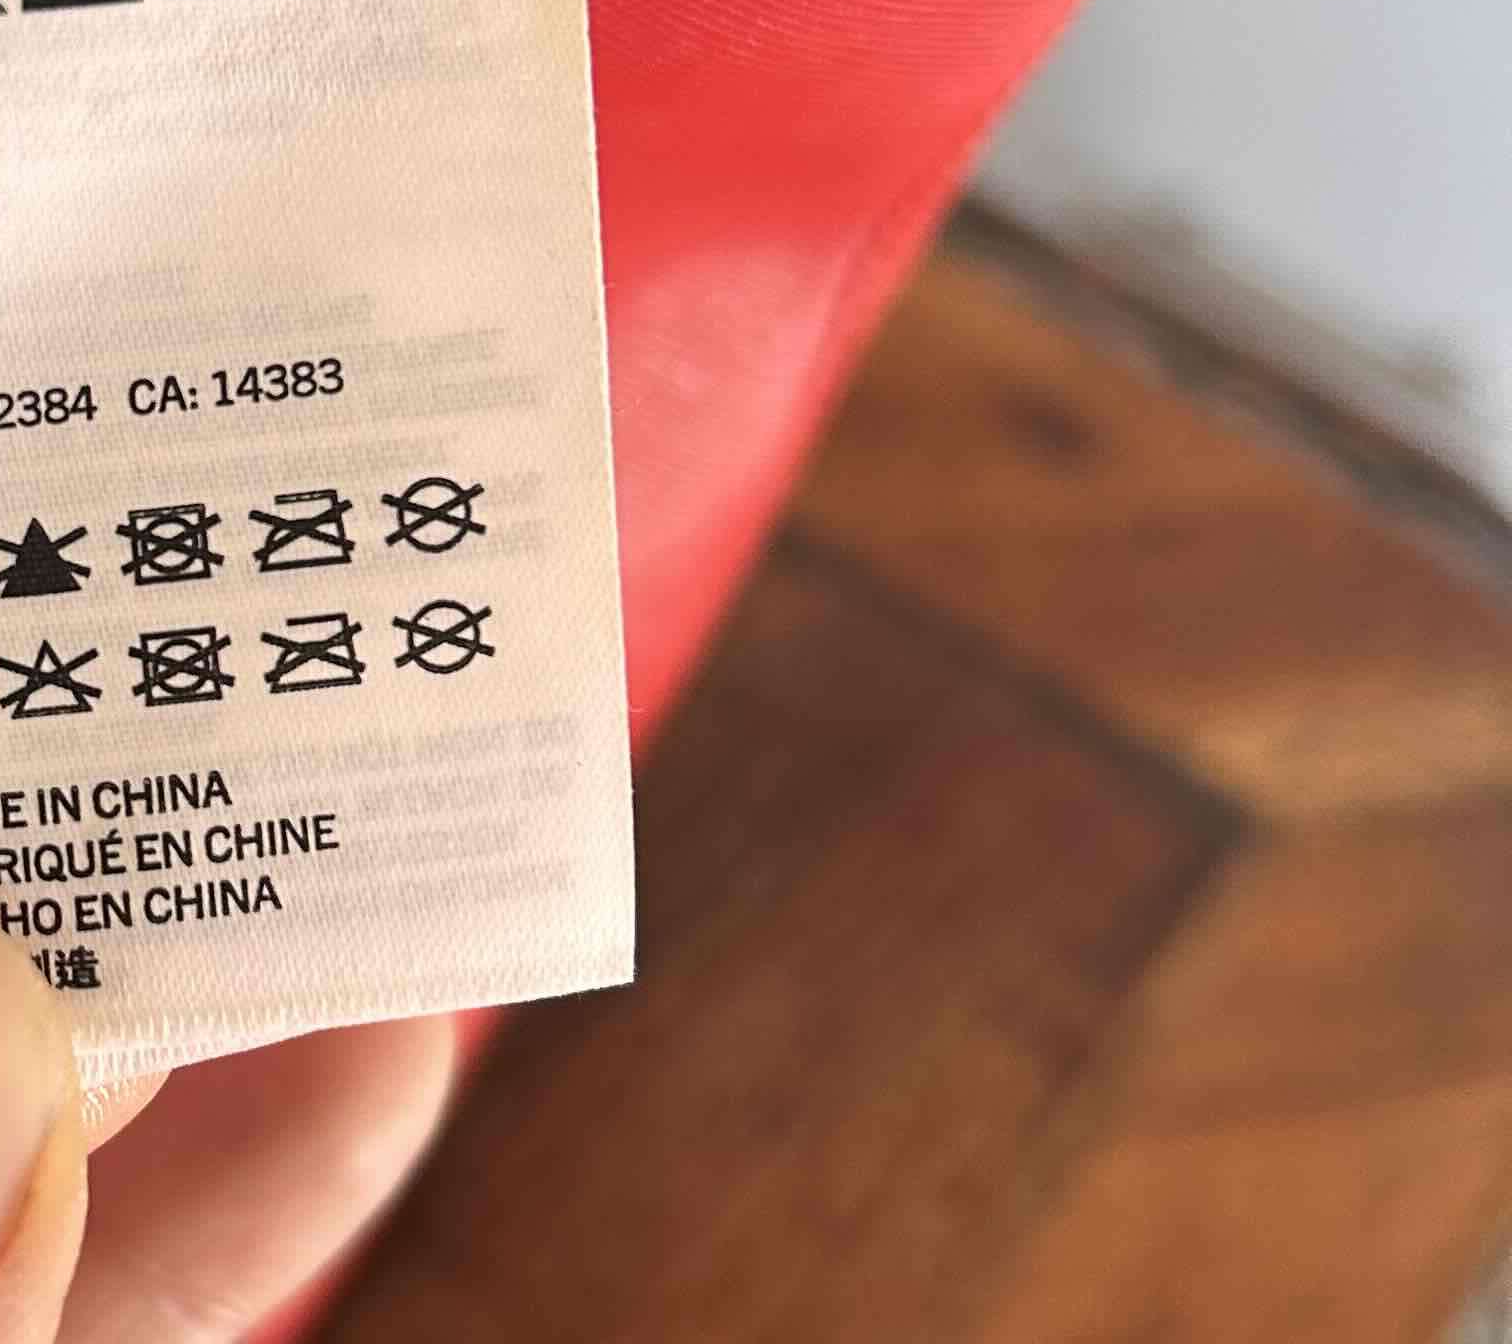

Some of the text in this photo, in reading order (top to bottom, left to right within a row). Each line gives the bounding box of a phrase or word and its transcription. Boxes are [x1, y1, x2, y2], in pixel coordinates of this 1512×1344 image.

[127, 375, 199, 416] CA:
[211, 357, 345, 407] 14383
[36, 784, 82, 827] IN
[91, 770, 233, 820] CHINA
[133, 829, 194, 872] EN
[204, 813, 340, 864] CHINE
[74, 890, 133, 933] EN
[143, 874, 283, 926] CHINA
